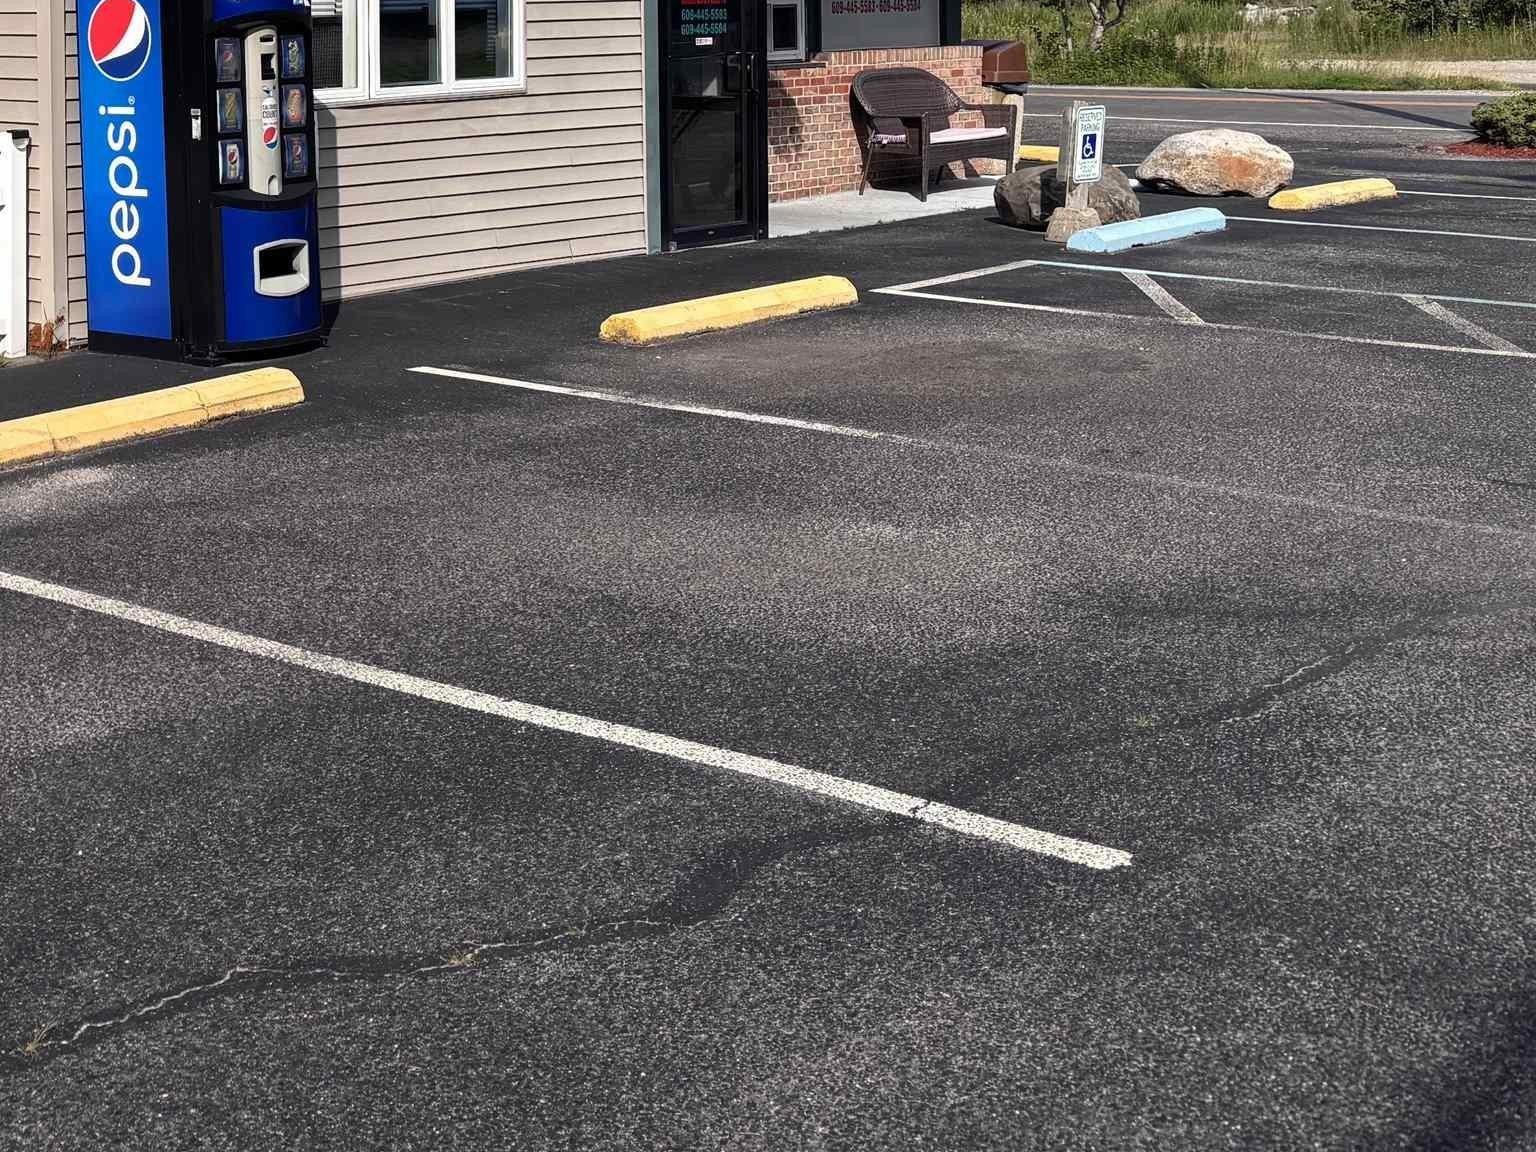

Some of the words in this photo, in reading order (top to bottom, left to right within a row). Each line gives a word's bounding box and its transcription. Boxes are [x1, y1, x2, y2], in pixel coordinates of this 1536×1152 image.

[1079, 111, 1103, 122] RESERVED
[1080, 122, 1100, 133] PARKING
[99, 105, 151, 287] pepsi
